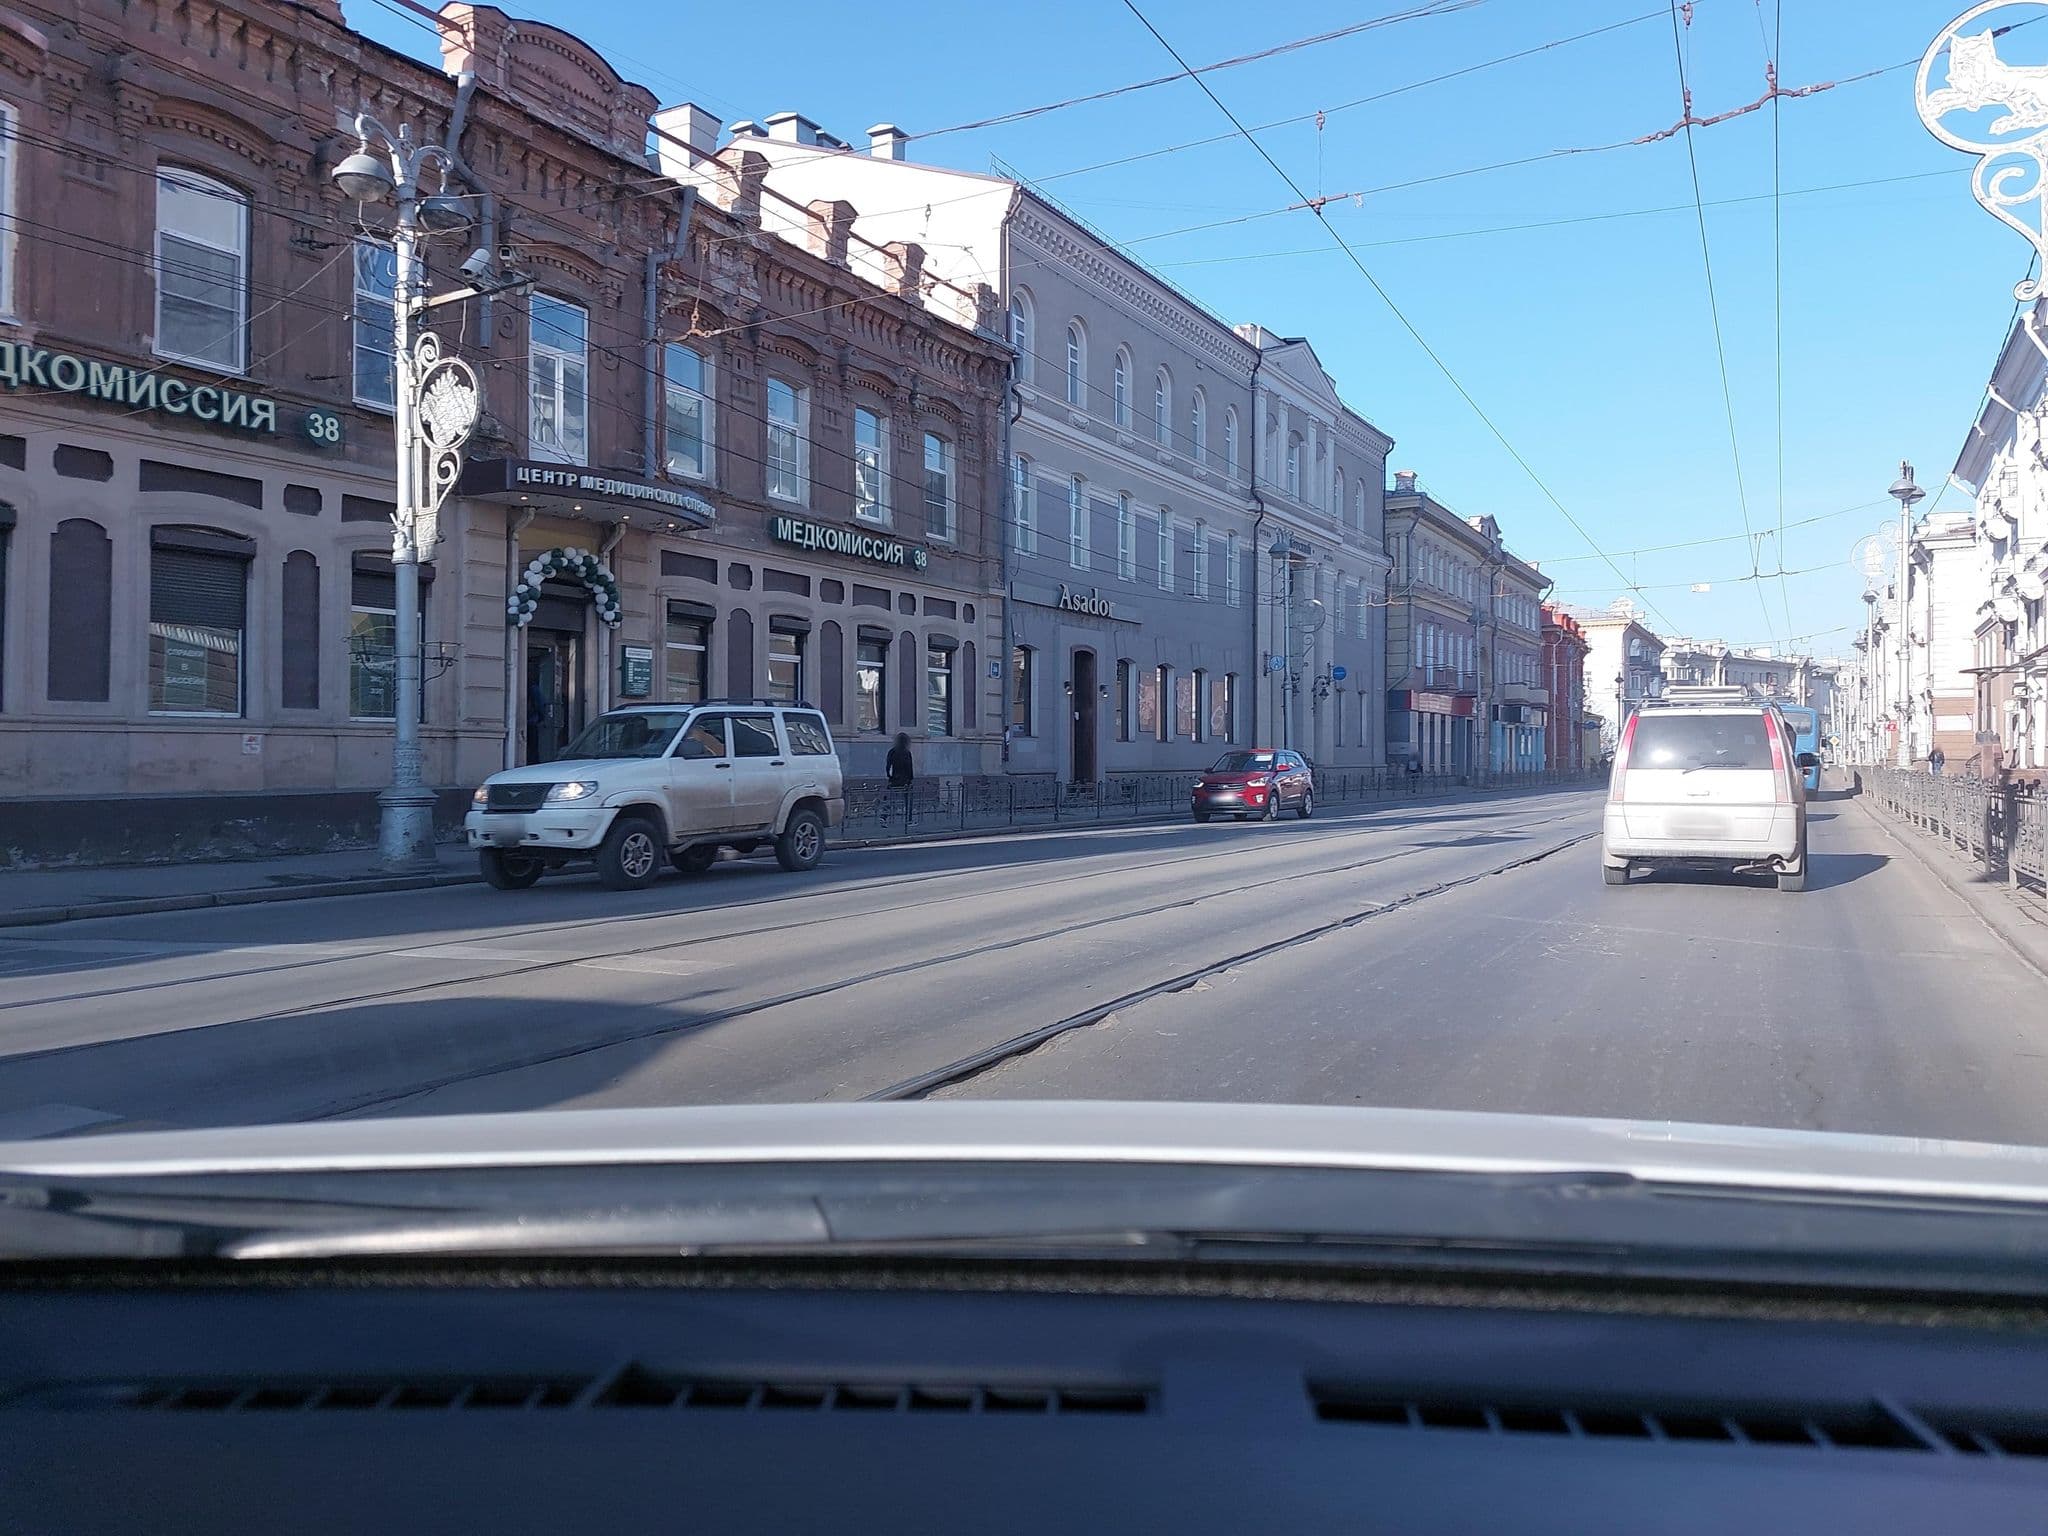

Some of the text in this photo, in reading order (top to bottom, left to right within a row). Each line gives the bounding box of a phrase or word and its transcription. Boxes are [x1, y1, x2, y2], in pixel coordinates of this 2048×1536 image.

[308, 412, 340, 443] 38
[516, 466, 578, 487] ЦЕНТР
[579, 475, 682, 507] МЕДИЦИНСКИХ
[777, 517, 927, 567] МЕДКОМИССИЯ 38
[1059, 583, 1117, 618] Asador
